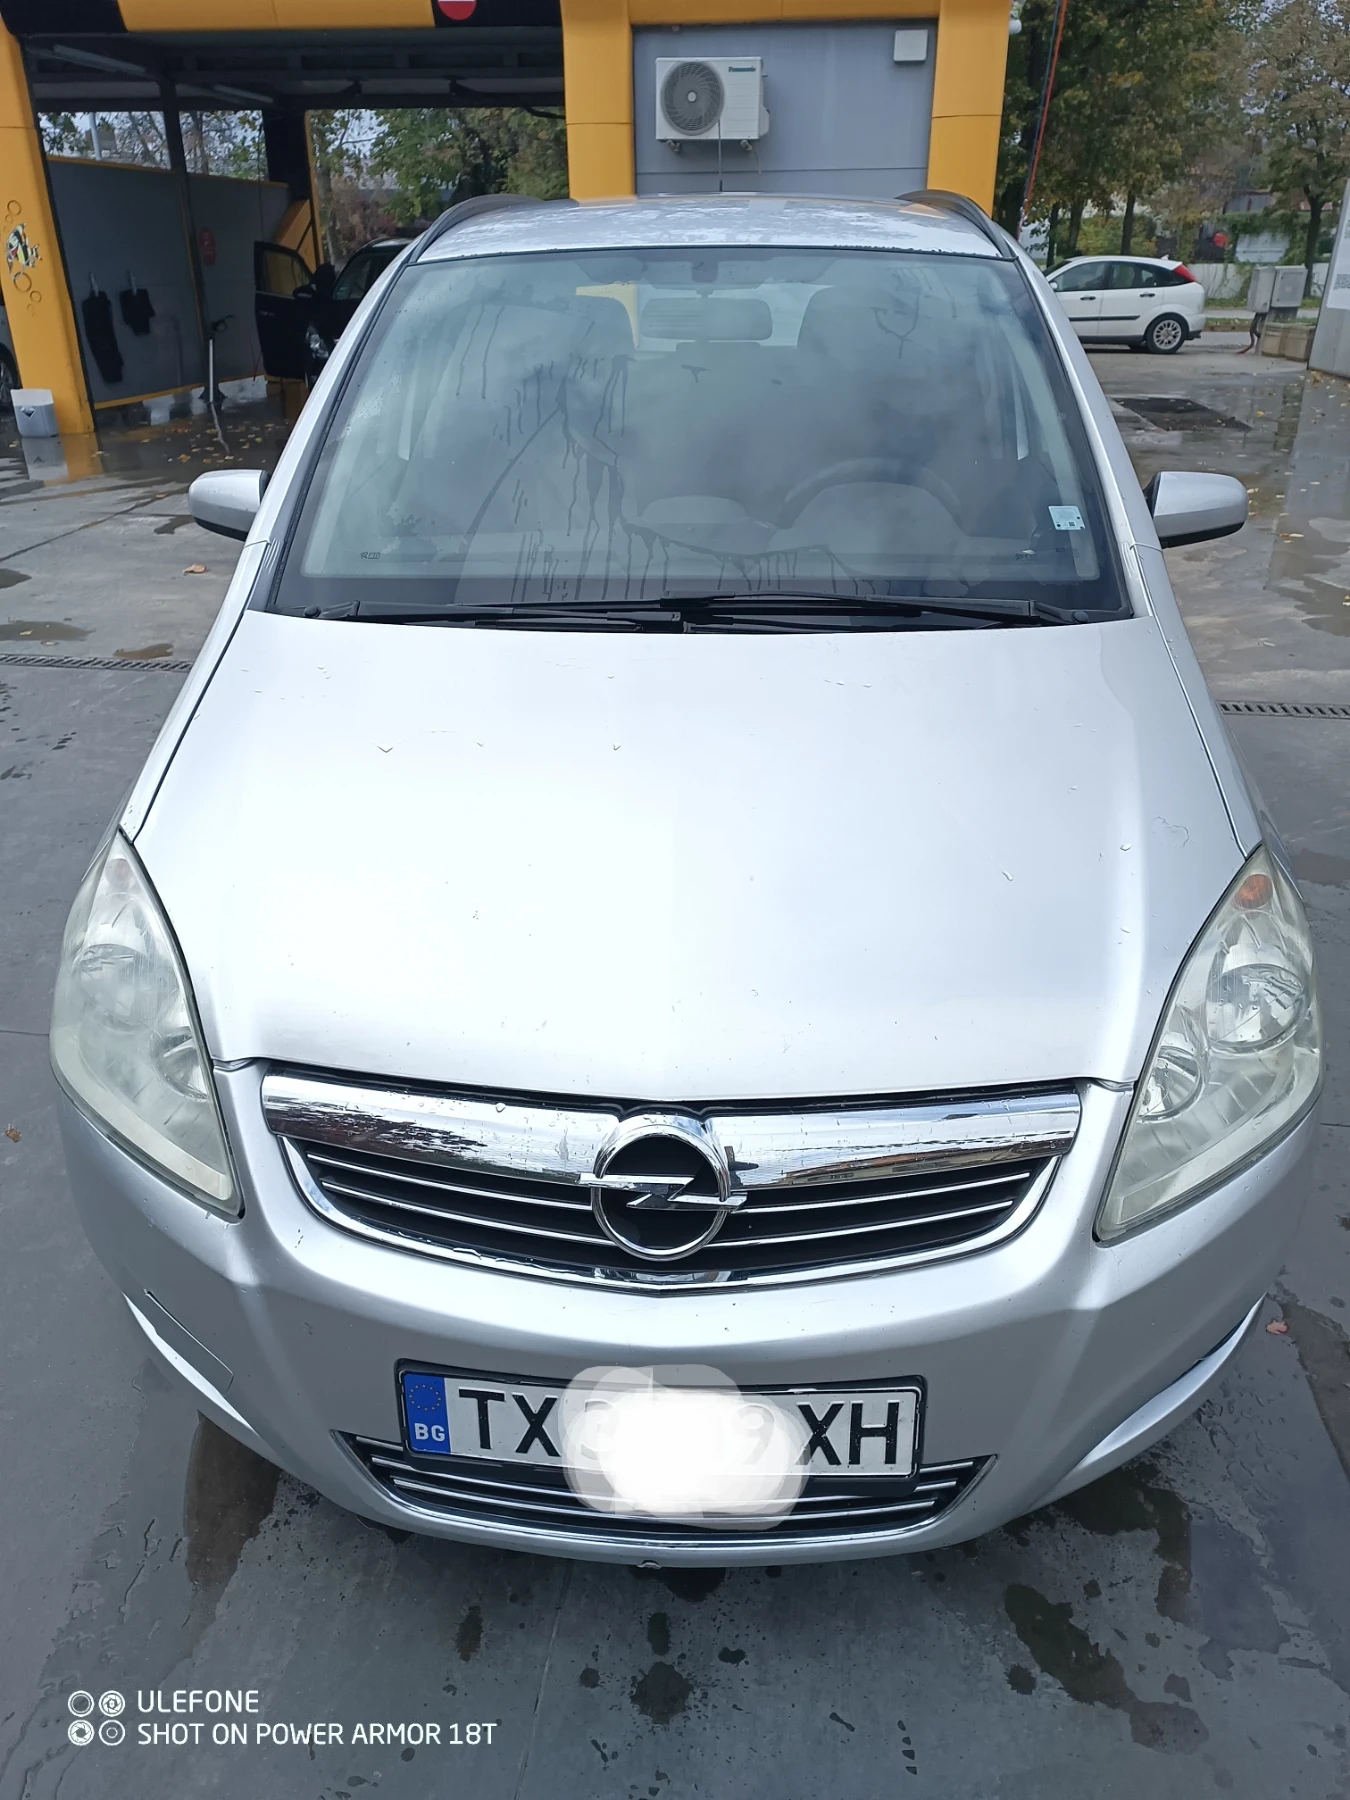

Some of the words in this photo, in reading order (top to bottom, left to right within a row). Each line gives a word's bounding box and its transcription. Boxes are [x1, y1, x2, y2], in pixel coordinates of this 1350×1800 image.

[414, 1422, 446, 1442] BG
[458, 1387, 562, 1458] TX
[795, 1400, 900, 1467] XH
